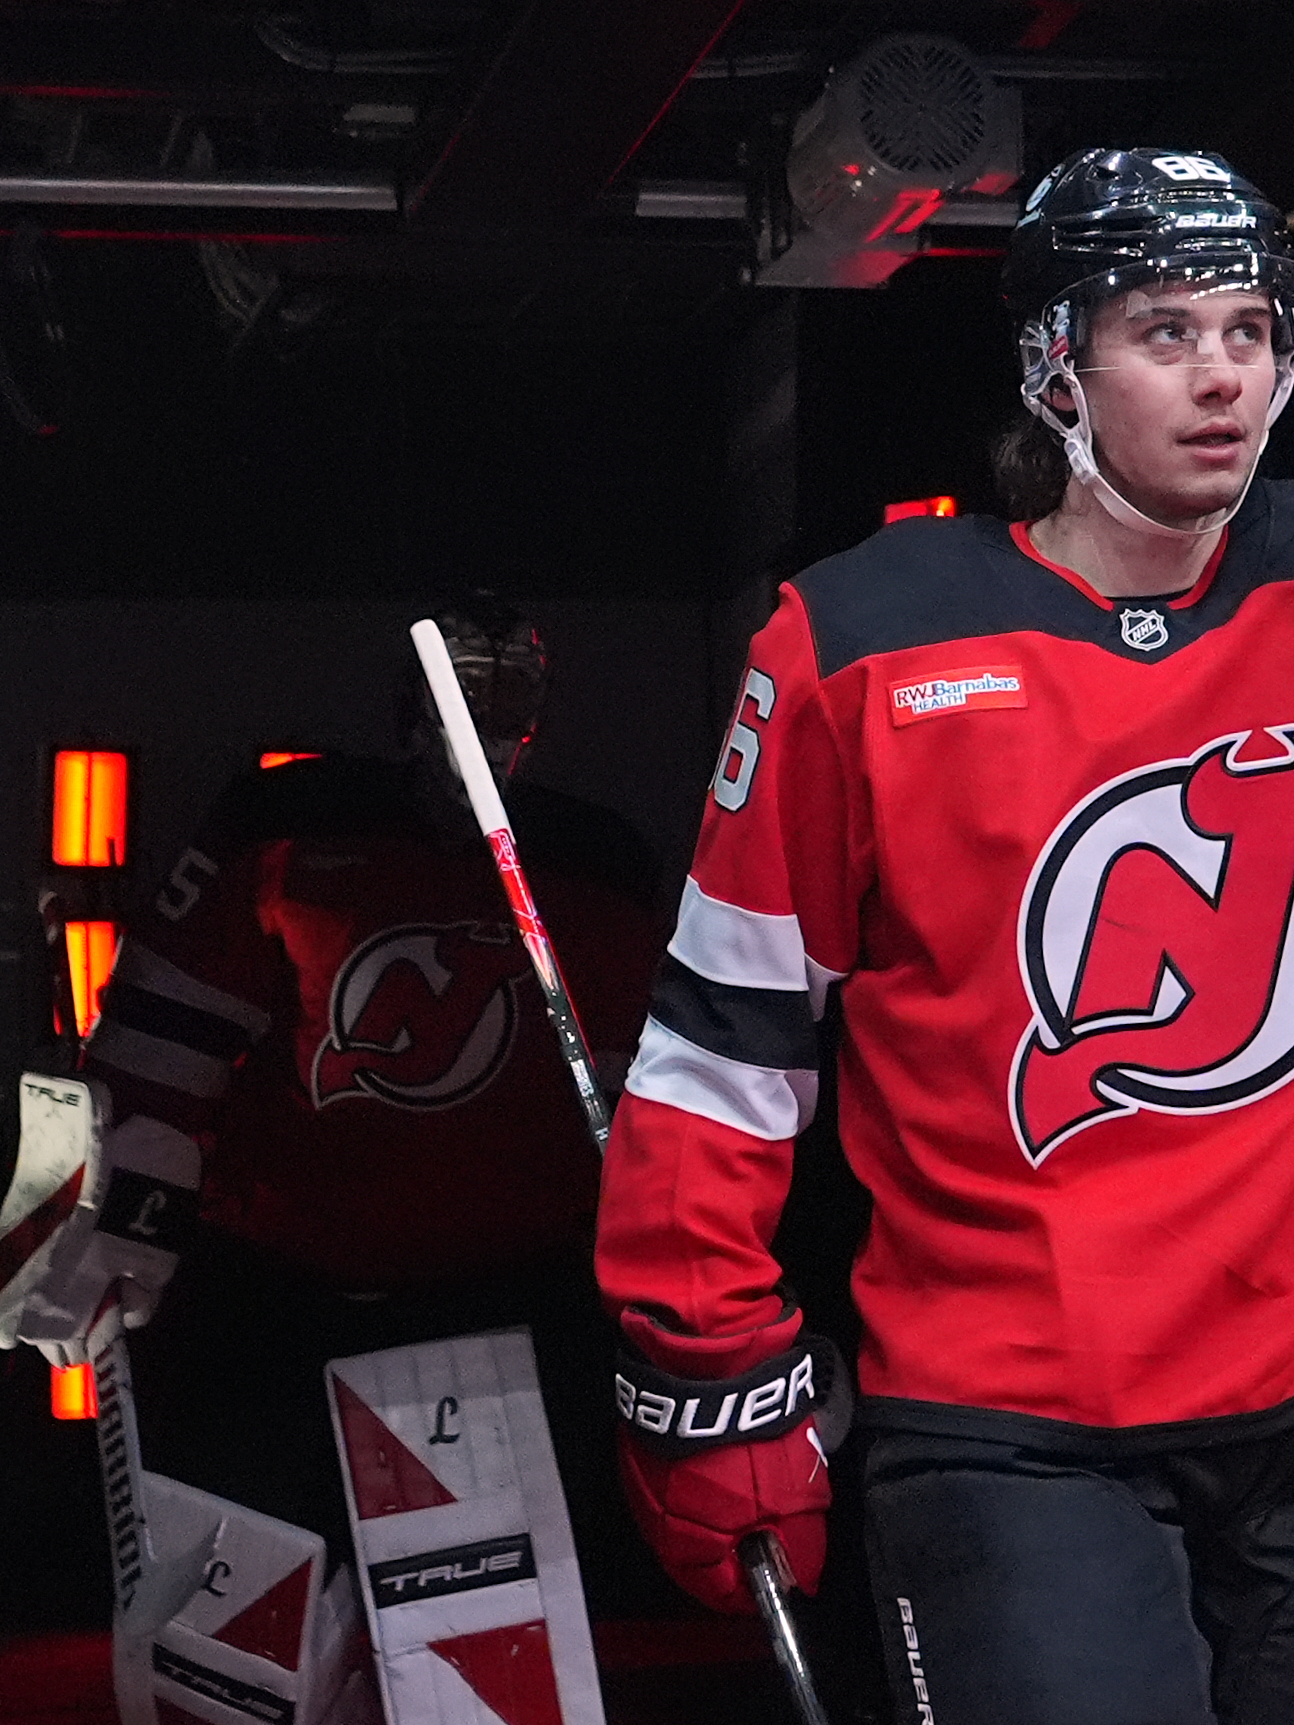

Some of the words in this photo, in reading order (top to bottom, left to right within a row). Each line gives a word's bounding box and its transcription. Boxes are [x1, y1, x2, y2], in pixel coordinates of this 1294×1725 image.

[1152, 156, 1231, 182] 86
[1175, 213, 1257, 229] BAUER
[1131, 620, 1158, 641] NHL
[913, 693, 964, 713] HEALTH
[615, 1353, 816, 1439] BAUER
[379, 1551, 524, 1593] TRUE
